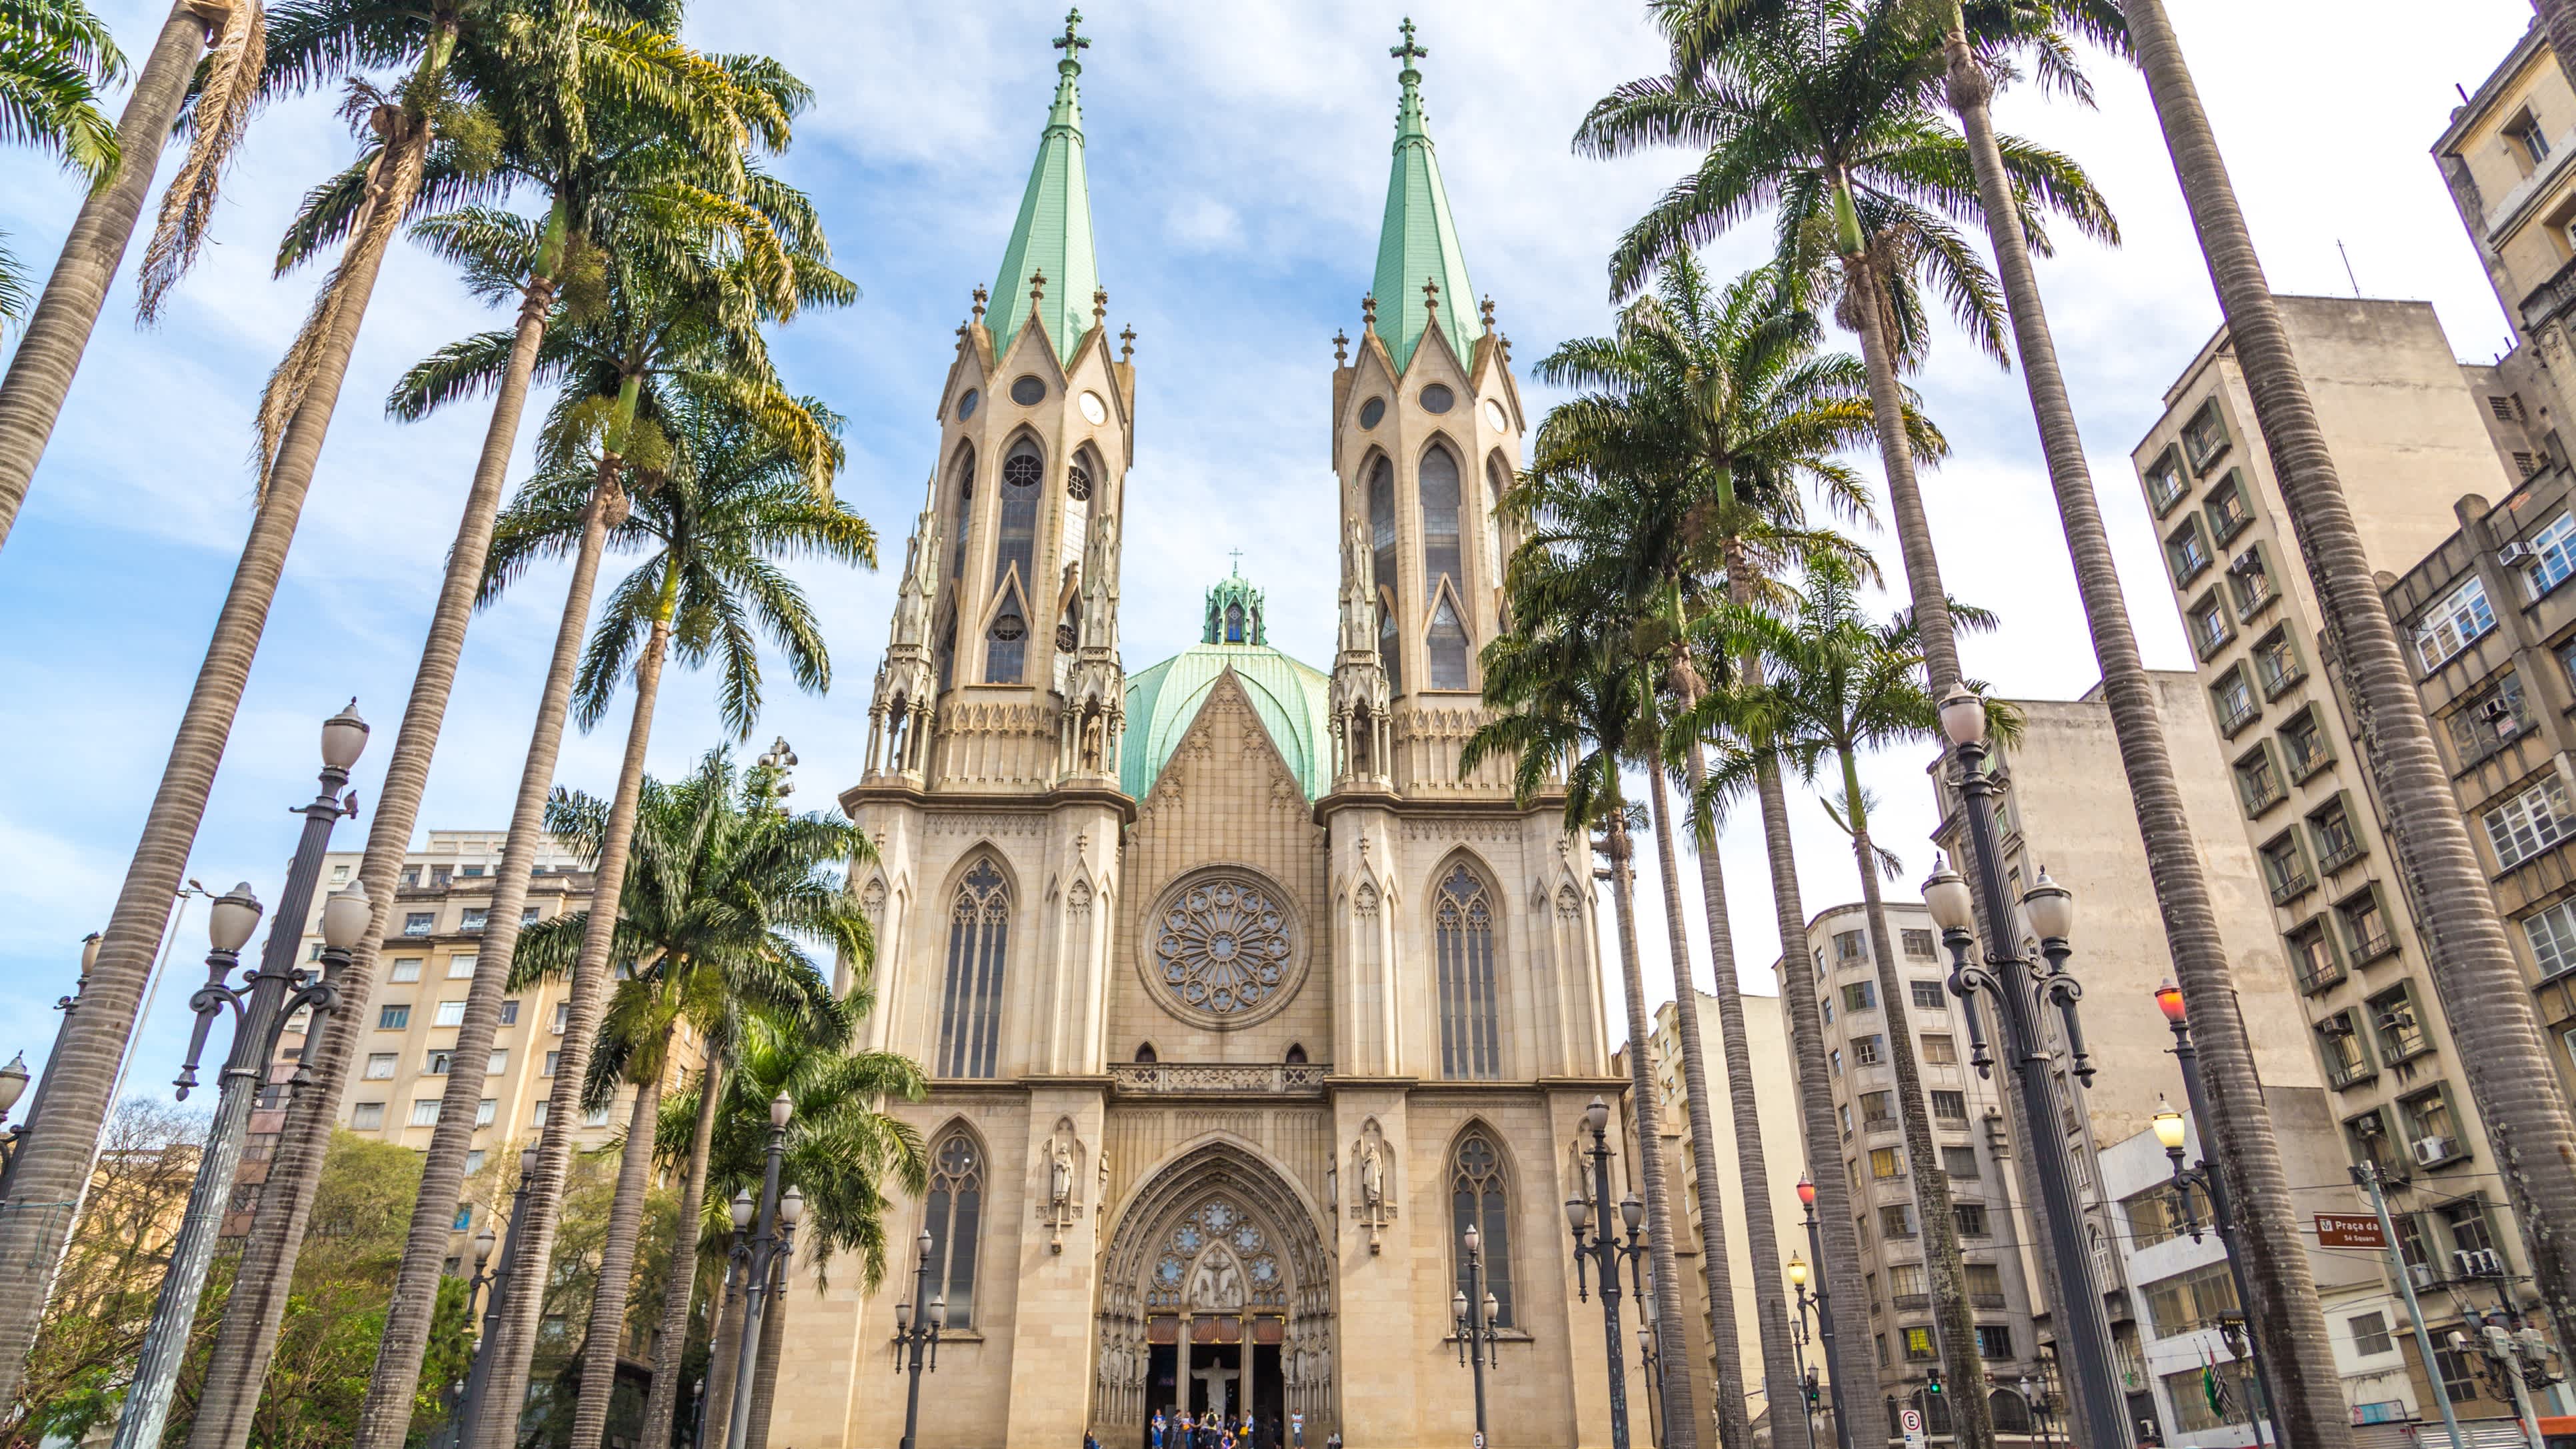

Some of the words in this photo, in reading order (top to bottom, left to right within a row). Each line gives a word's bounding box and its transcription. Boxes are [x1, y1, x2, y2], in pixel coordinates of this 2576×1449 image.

[2335, 1221, 2363, 1232] Praça
[2366, 1222, 2379, 1230] da
[1908, 1416, 1915, 1426] E
[1475, 1434, 1481, 1446] E
